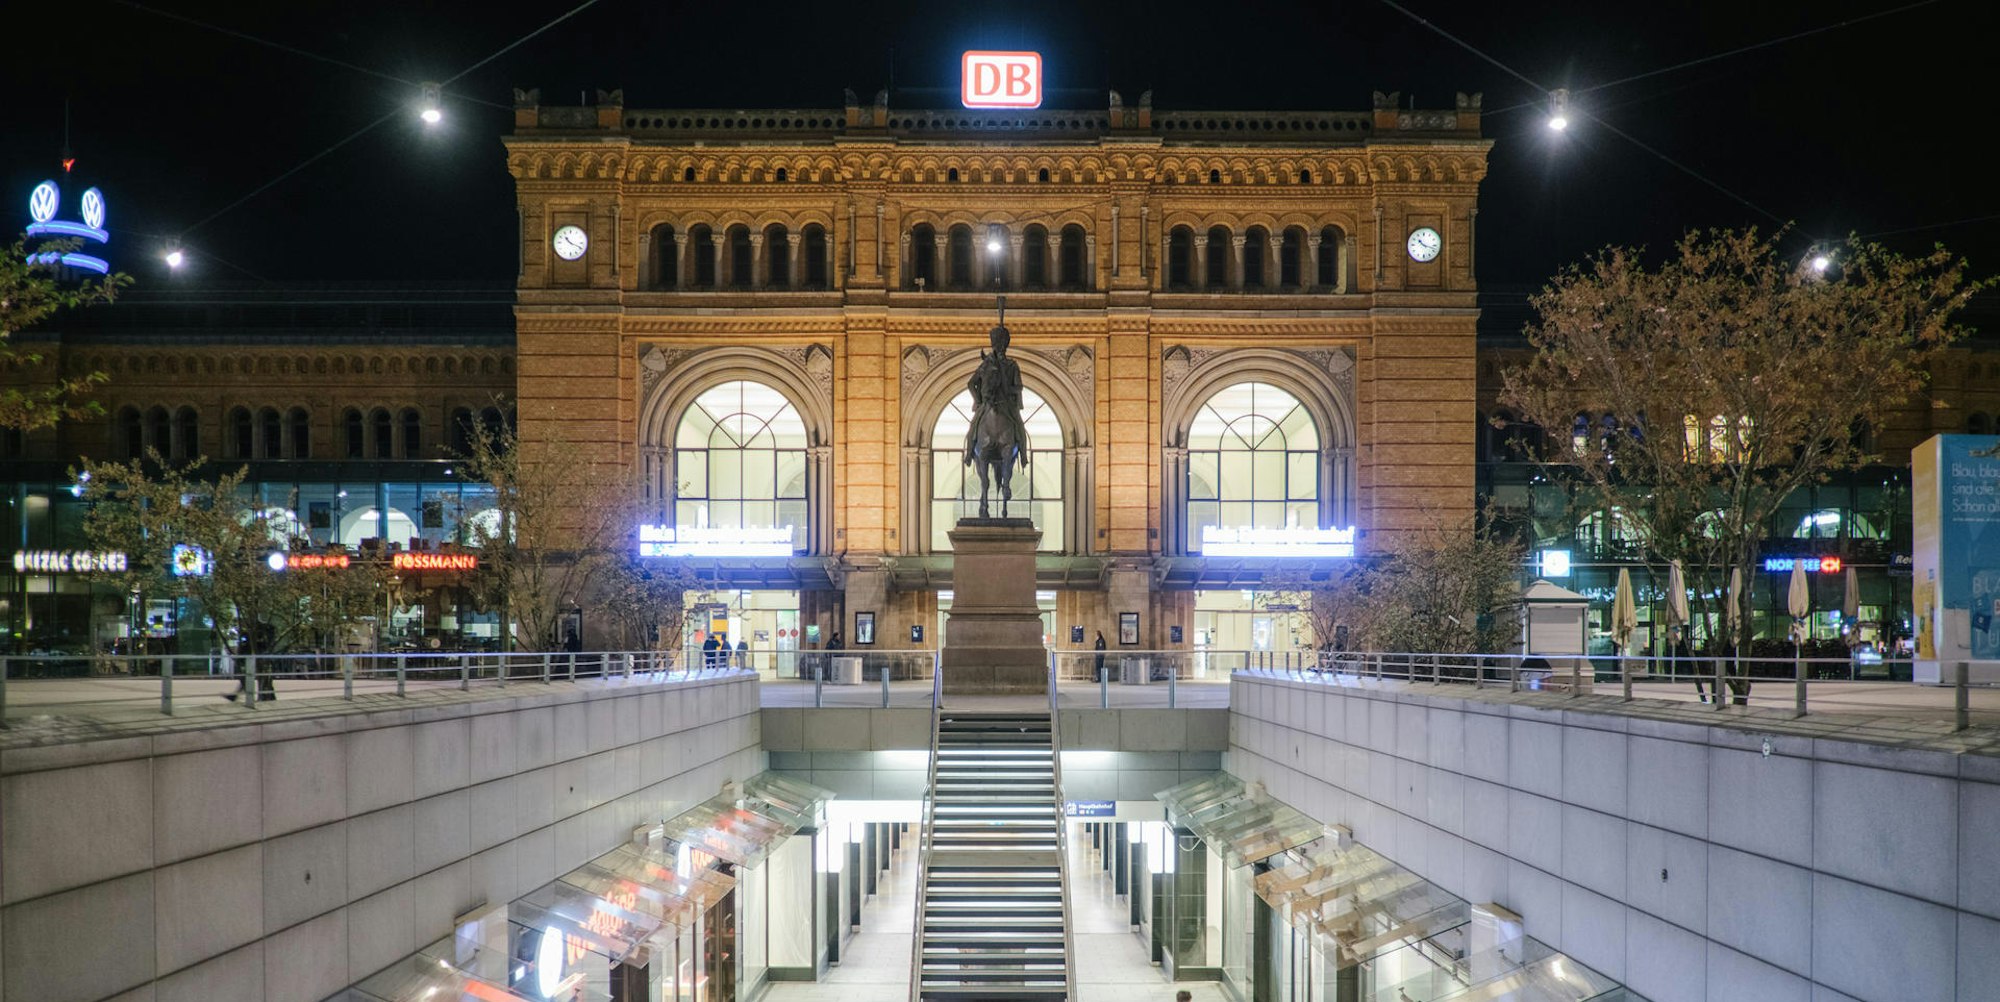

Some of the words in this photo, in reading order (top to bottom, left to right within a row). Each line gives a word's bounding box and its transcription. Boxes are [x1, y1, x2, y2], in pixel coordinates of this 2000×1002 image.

[974, 62, 1032, 97] DB
[1952, 481, 1973, 495] sind
[394, 553, 476, 569] ROSSMANN
[1765, 558, 1820, 571] NORSEE
